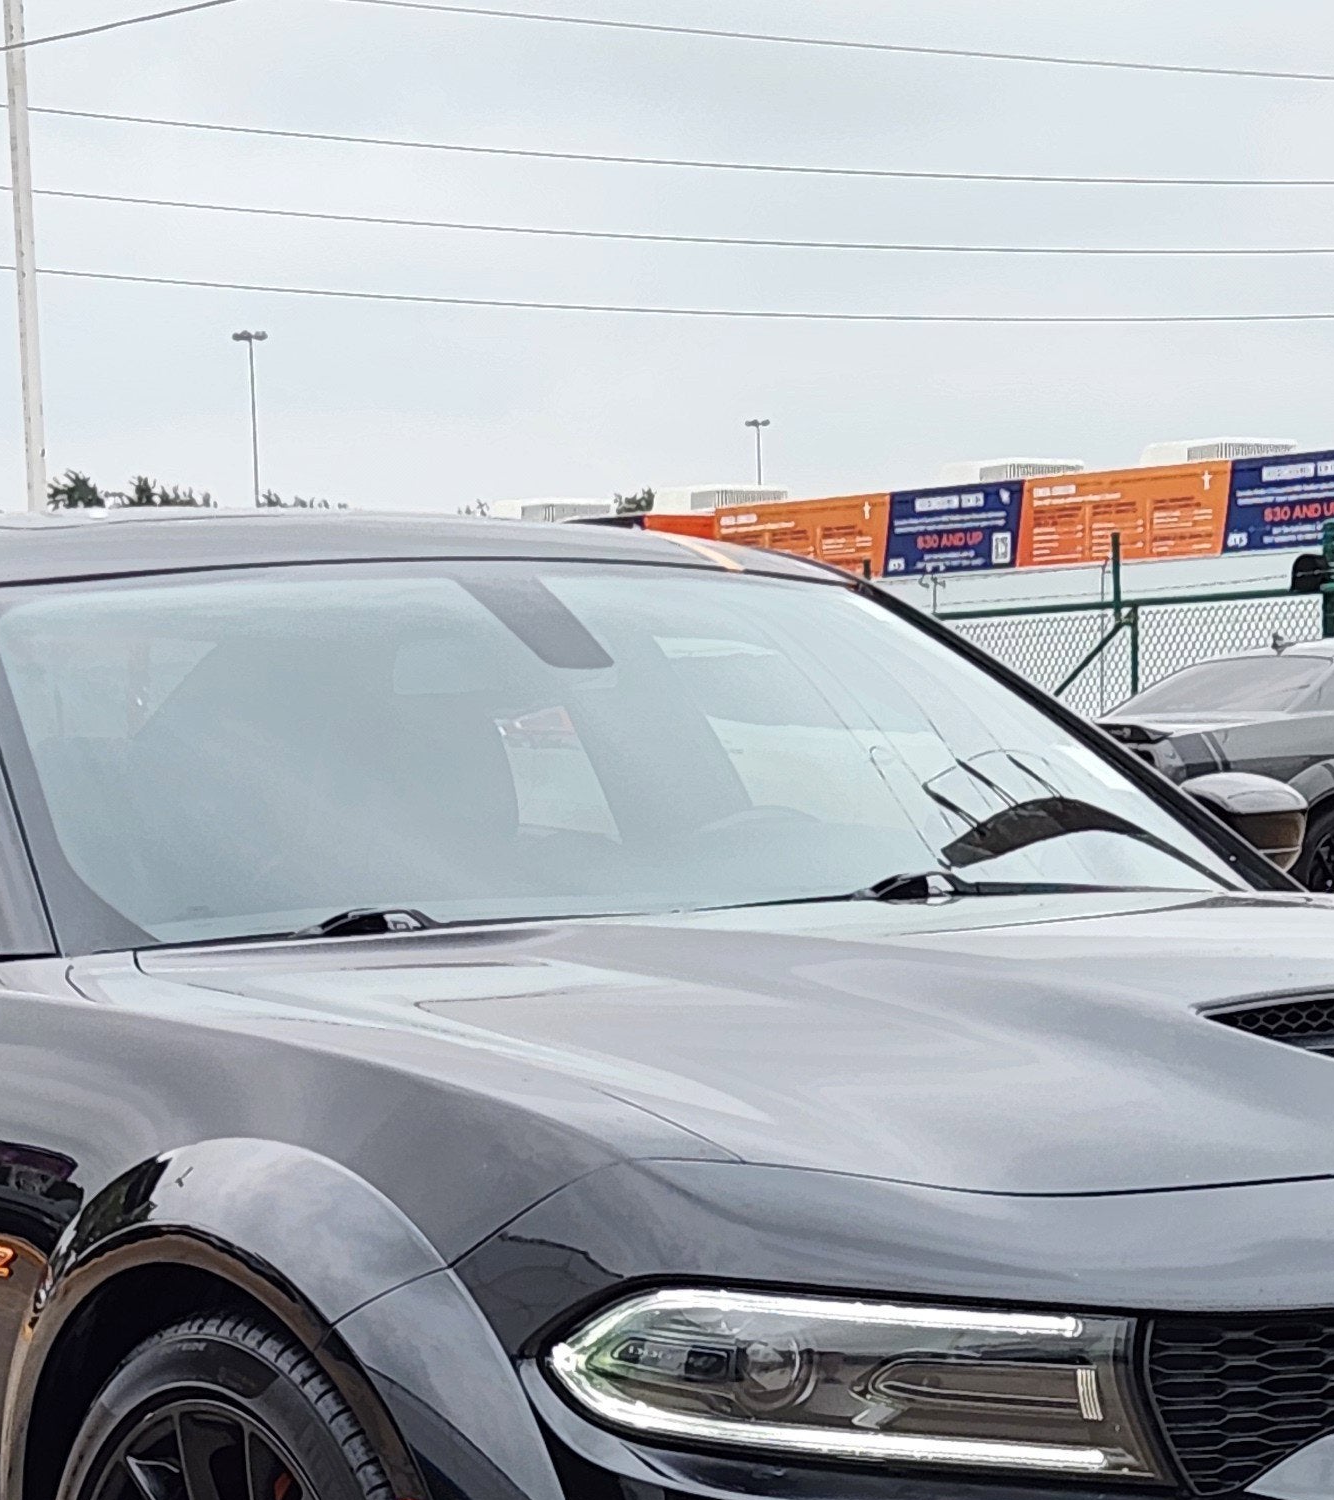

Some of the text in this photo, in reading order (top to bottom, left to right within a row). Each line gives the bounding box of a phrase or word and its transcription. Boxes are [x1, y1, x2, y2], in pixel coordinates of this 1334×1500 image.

[1293, 503, 1321, 520] AND
[941, 532, 965, 548] AND
[966, 531, 984, 546] UP
